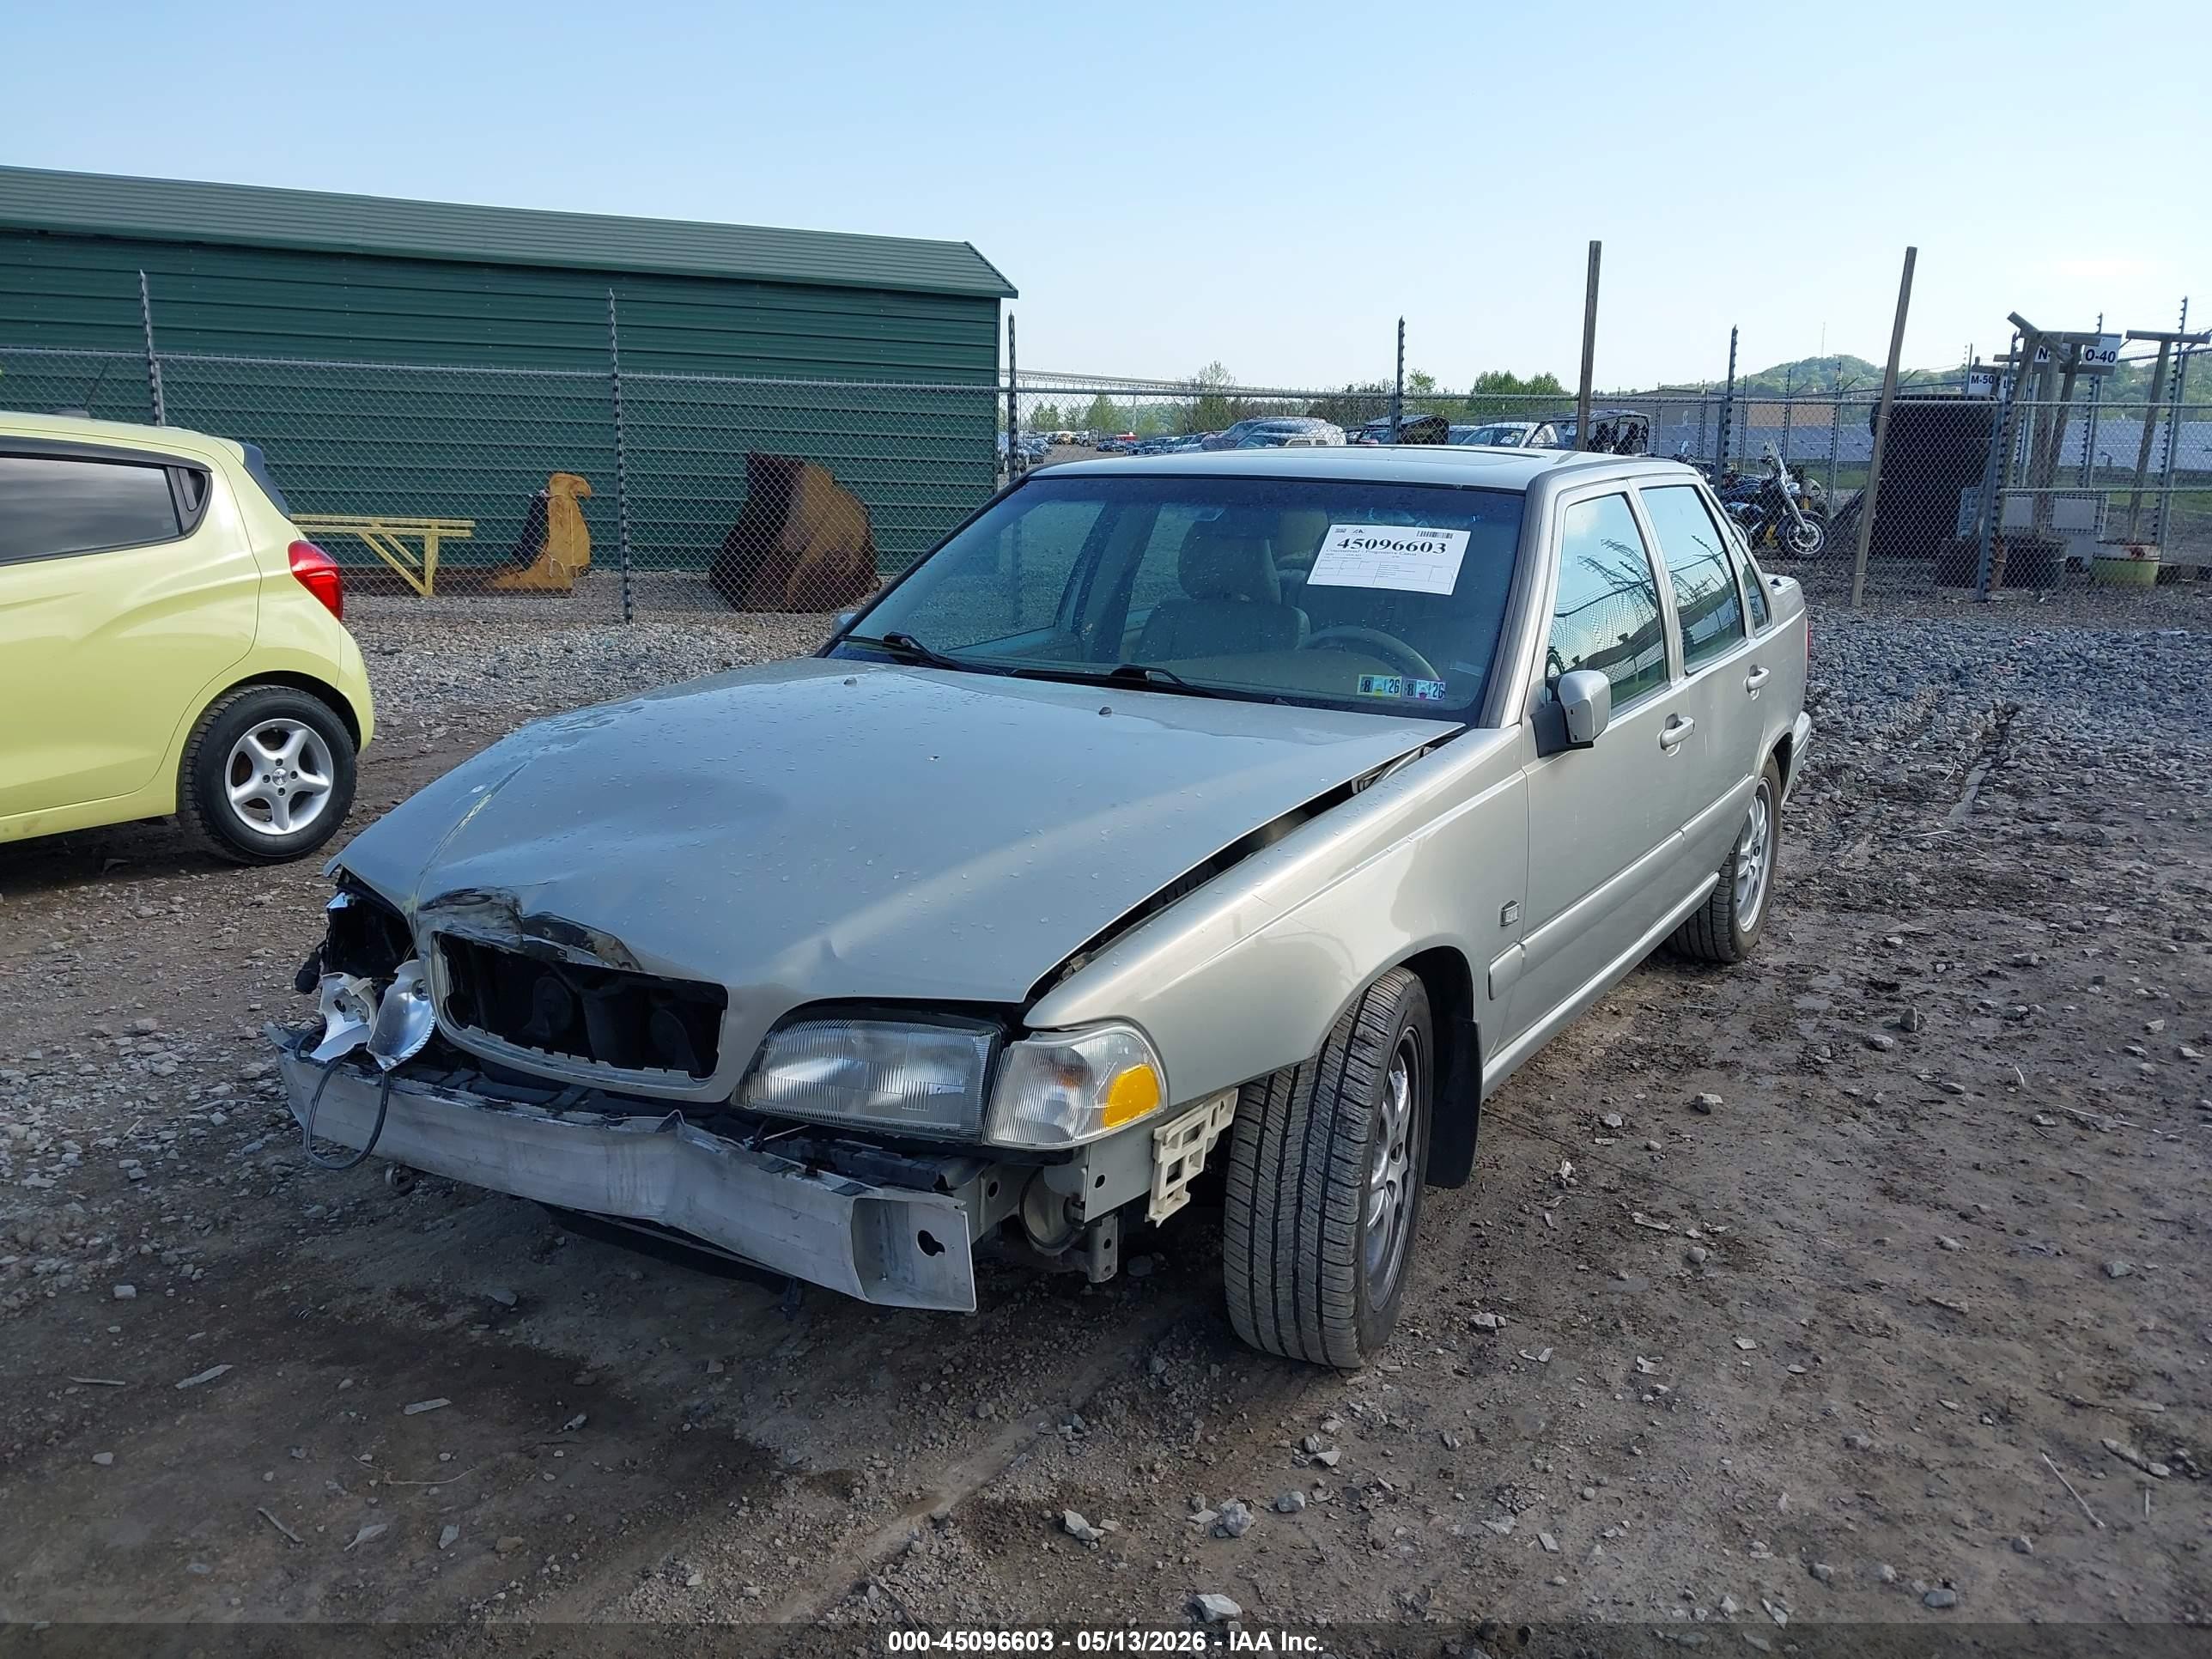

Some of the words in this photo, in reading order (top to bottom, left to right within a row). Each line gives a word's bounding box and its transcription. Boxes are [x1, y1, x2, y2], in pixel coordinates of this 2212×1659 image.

[2085, 349, 2116, 363] O-40
[1971, 374, 1994, 384] M-50
[1337, 538, 1446, 554] 45096603
[1389, 679, 1400, 694] 26
[1433, 683, 1444, 698] 26
